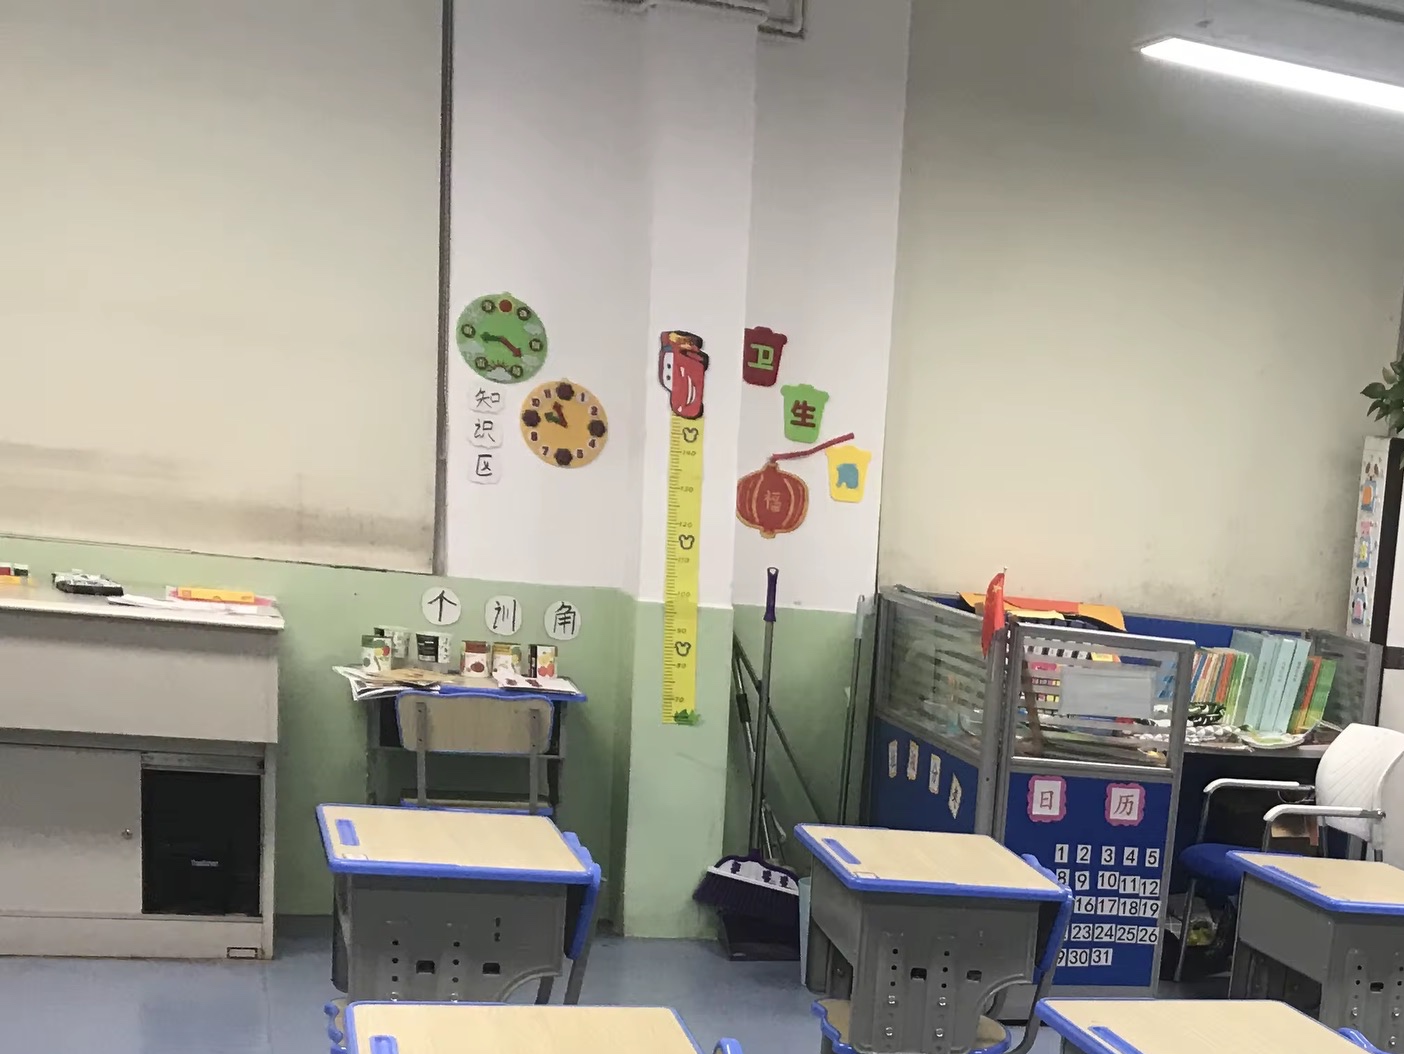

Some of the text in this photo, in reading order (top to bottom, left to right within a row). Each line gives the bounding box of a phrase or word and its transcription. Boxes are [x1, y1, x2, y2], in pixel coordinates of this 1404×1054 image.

[590, 405, 599, 416] 2
[474, 386, 501, 477] 知识区
[427, 590, 578, 635] 个训角
[1057, 846, 1157, 865] 1 2 3 4 5
[1057, 871, 1159, 896] 8 9 10 11 12
[1076, 897, 1159, 917] 16 17 18 19
[1072, 925, 1158, 943] 23 24 25 26
[1069, 950, 1088, 965] 30
[1092, 949, 1109, 964] 31
